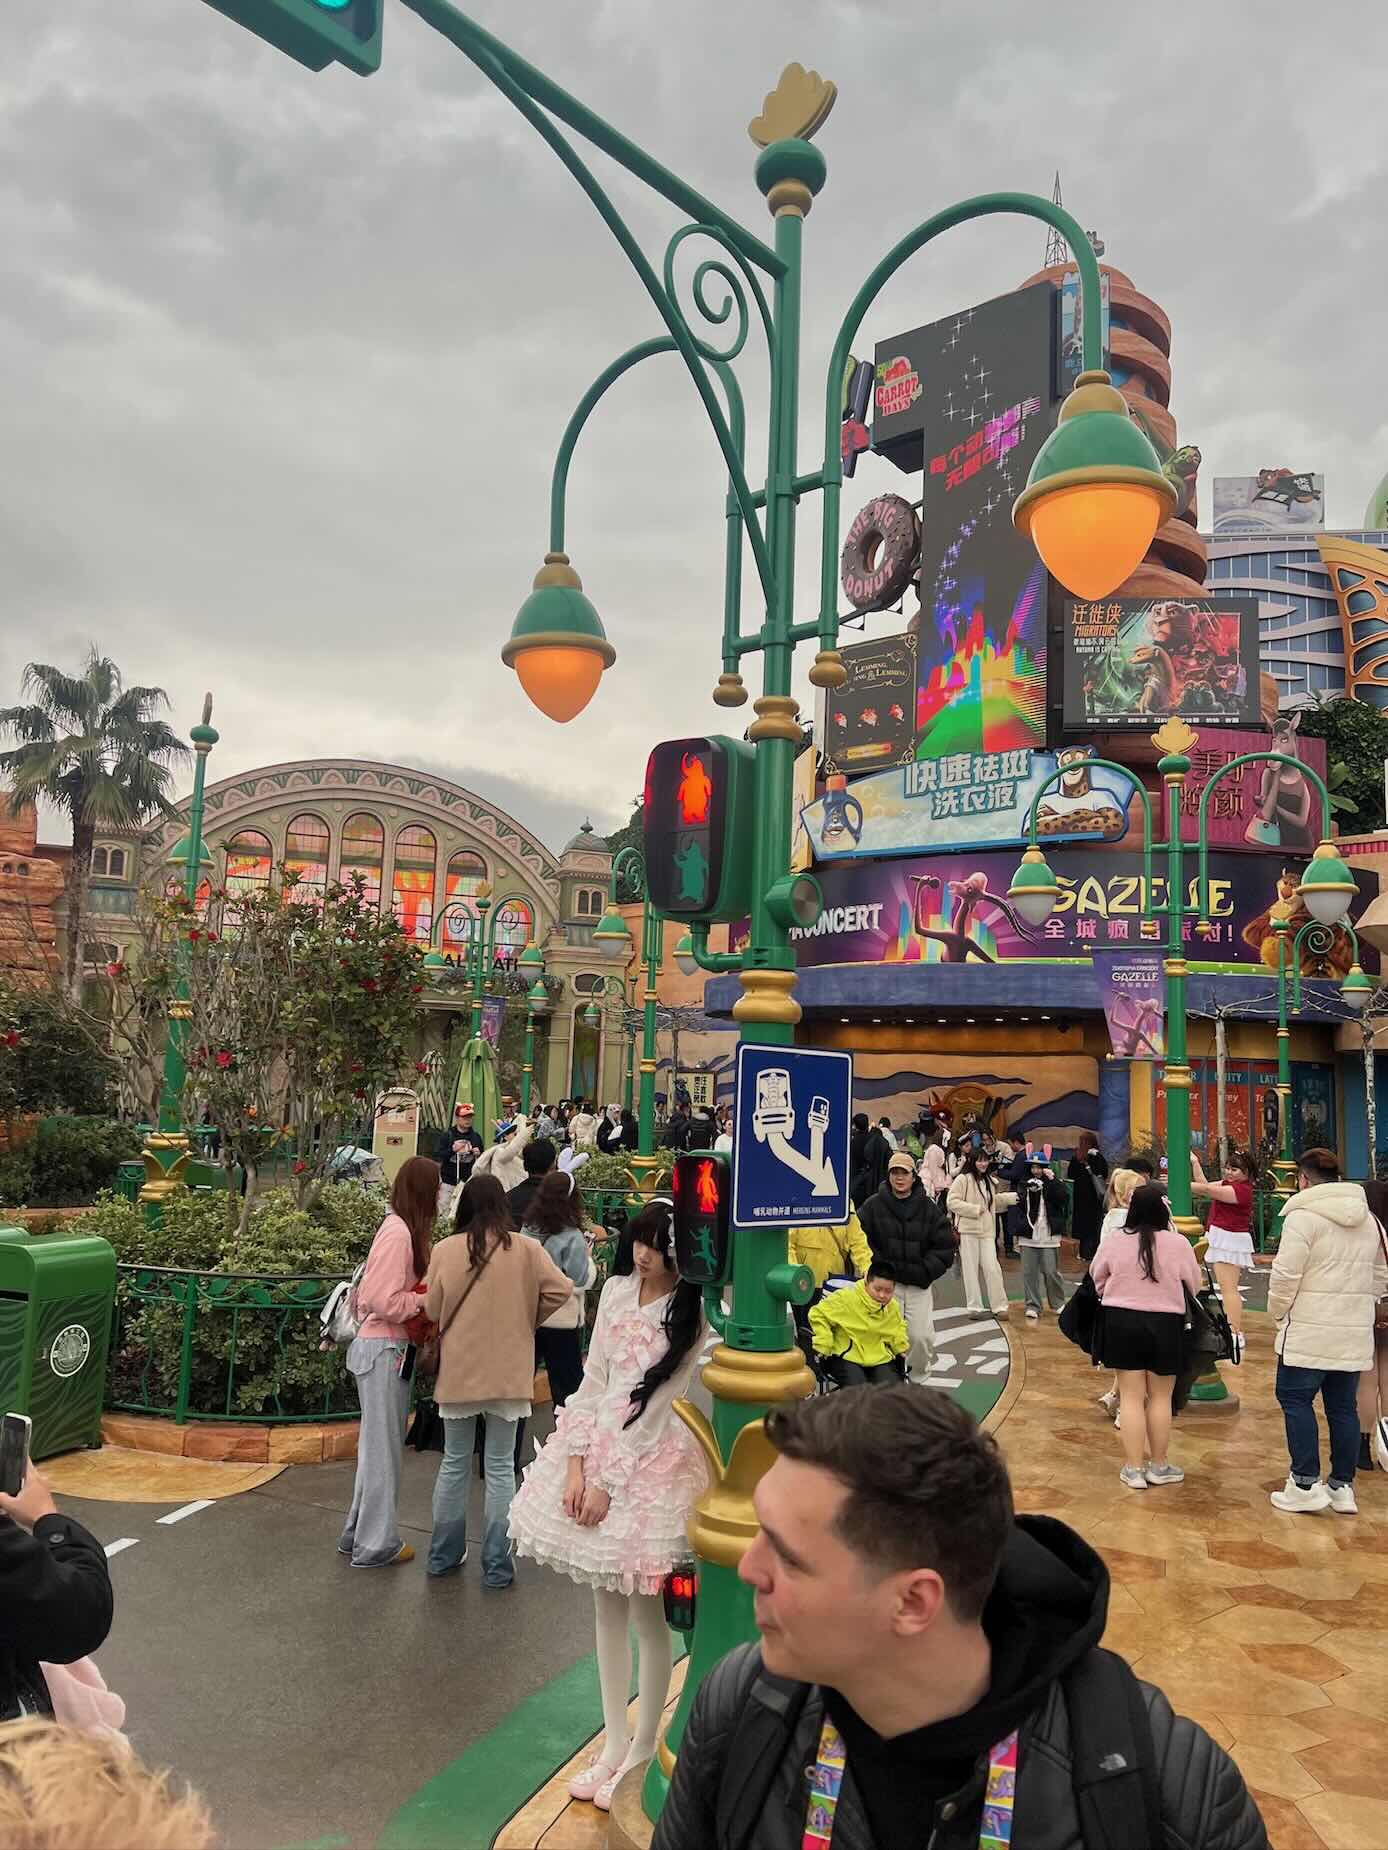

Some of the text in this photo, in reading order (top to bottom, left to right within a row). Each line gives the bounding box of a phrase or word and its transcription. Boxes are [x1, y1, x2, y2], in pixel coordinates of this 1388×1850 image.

[876, 375, 919, 405] CARROT
[847, 501, 897, 544] THE BIG
[846, 558, 895, 599] DONUT
[1071, 603, 1121, 625] 迁徙侠
[904, 749, 1030, 796] 快速祛斑
[932, 782, 1015, 817] 洗衣液
[1052, 874, 1234, 919] GAZELE
[1111, 972, 1160, 982] GAZELLE
